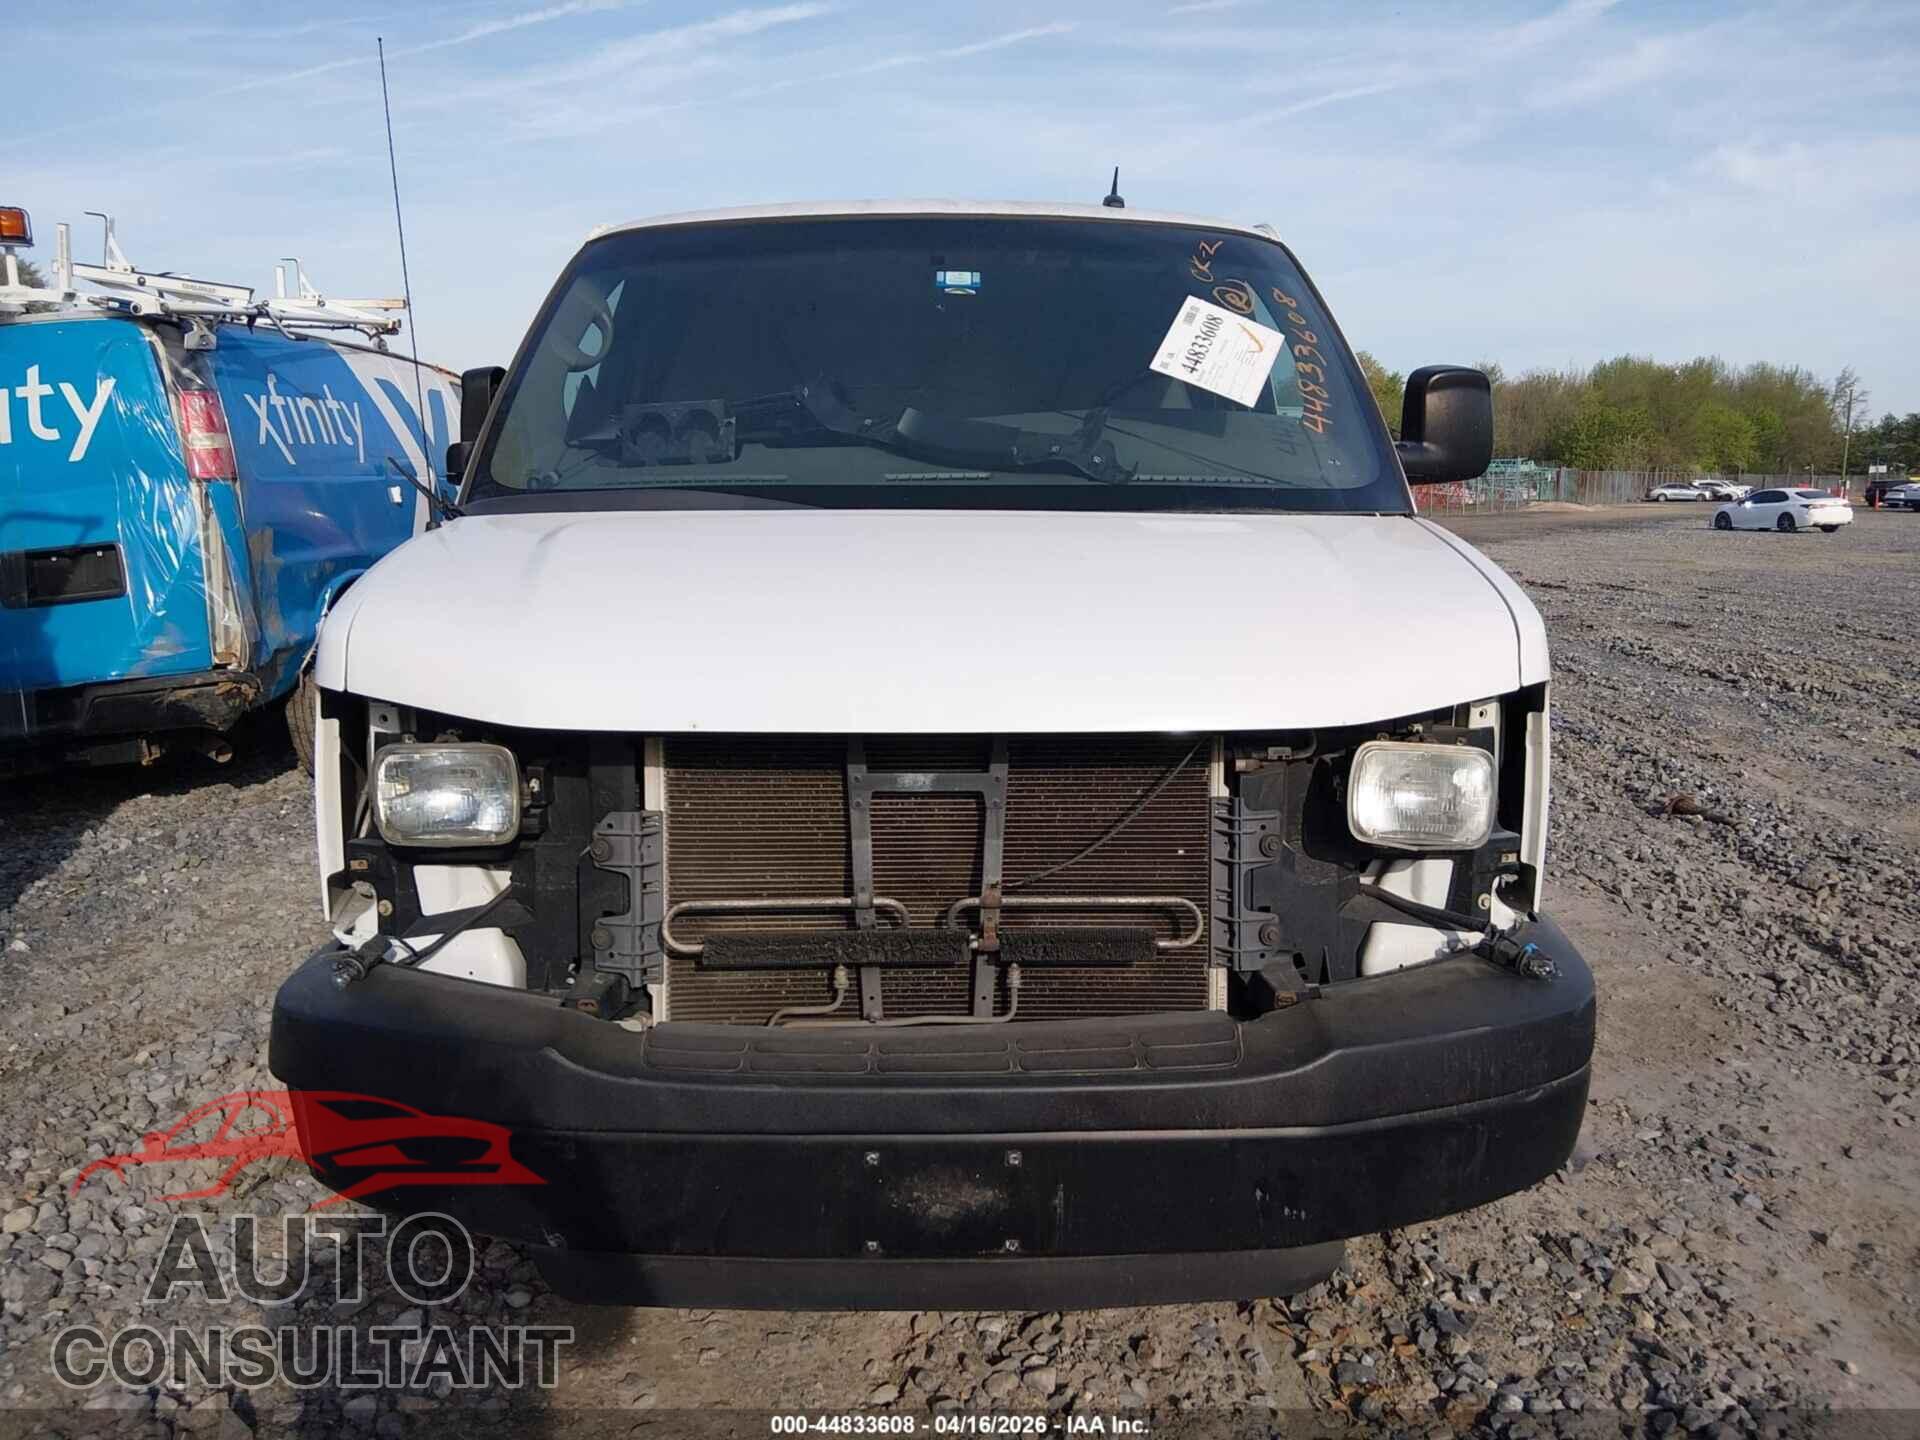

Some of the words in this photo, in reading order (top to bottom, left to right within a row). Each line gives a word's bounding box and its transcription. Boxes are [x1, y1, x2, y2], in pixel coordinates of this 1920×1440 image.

[1182, 313, 1225, 374] 44833608
[1271, 286, 1334, 434] 44833608
[243, 372, 365, 465] xfinity
